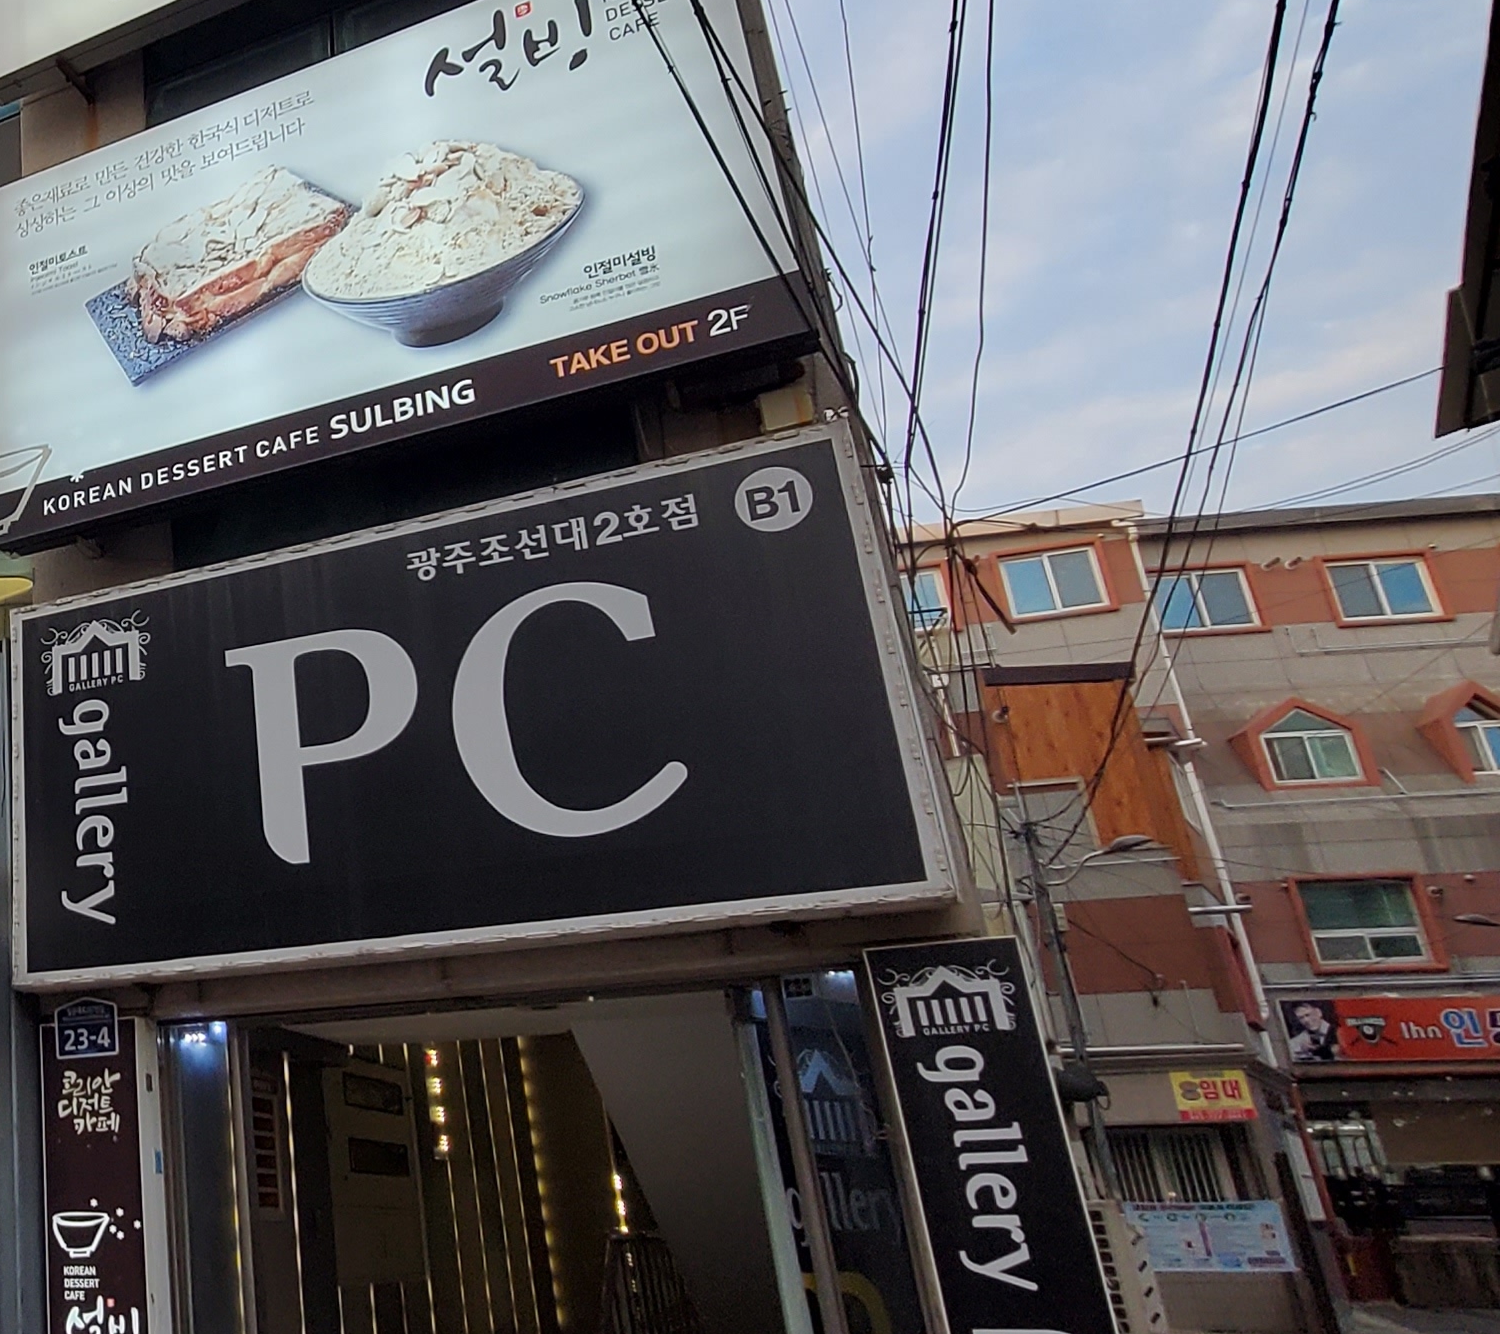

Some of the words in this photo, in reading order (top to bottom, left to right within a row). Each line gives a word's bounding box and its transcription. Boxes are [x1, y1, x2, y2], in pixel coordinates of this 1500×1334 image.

[609, 11, 660, 41] CAFE
[583, 245, 657, 279] 인절미설빙
[549, 339, 631, 378] TAKE
[636, 320, 698, 355] OUT
[707, 304, 751, 337] 2F
[42, 477, 133, 516] KOREAN
[140, 445, 250, 490] DESSERT
[255, 426, 320, 459] CAFE
[329, 378, 477, 440] SULBING
[745, 481, 802, 523] B1
[406, 493, 700, 583] 광주조선대2호점
[68, 677, 108, 692] GALLERY
[110, 674, 124, 684] PC
[225, 581, 688, 865] PC
[58, 699, 129, 926] gallery
[64, 1026, 111, 1051] 23-4
[923, 1025, 970, 1036] GALLERY
[974, 1023, 990, 1032] PC
[1200, 1080, 1242, 1100] 임대
[57, 1093, 114, 1118] 디저트
[73, 1112, 120, 1135] 카페
[917, 1045, 1038, 1292] gallery
[63, 1266, 97, 1276] KOREAN
[64, 1278, 100, 1288] DESSERT
[64, 1290, 86, 1301] CAFE
